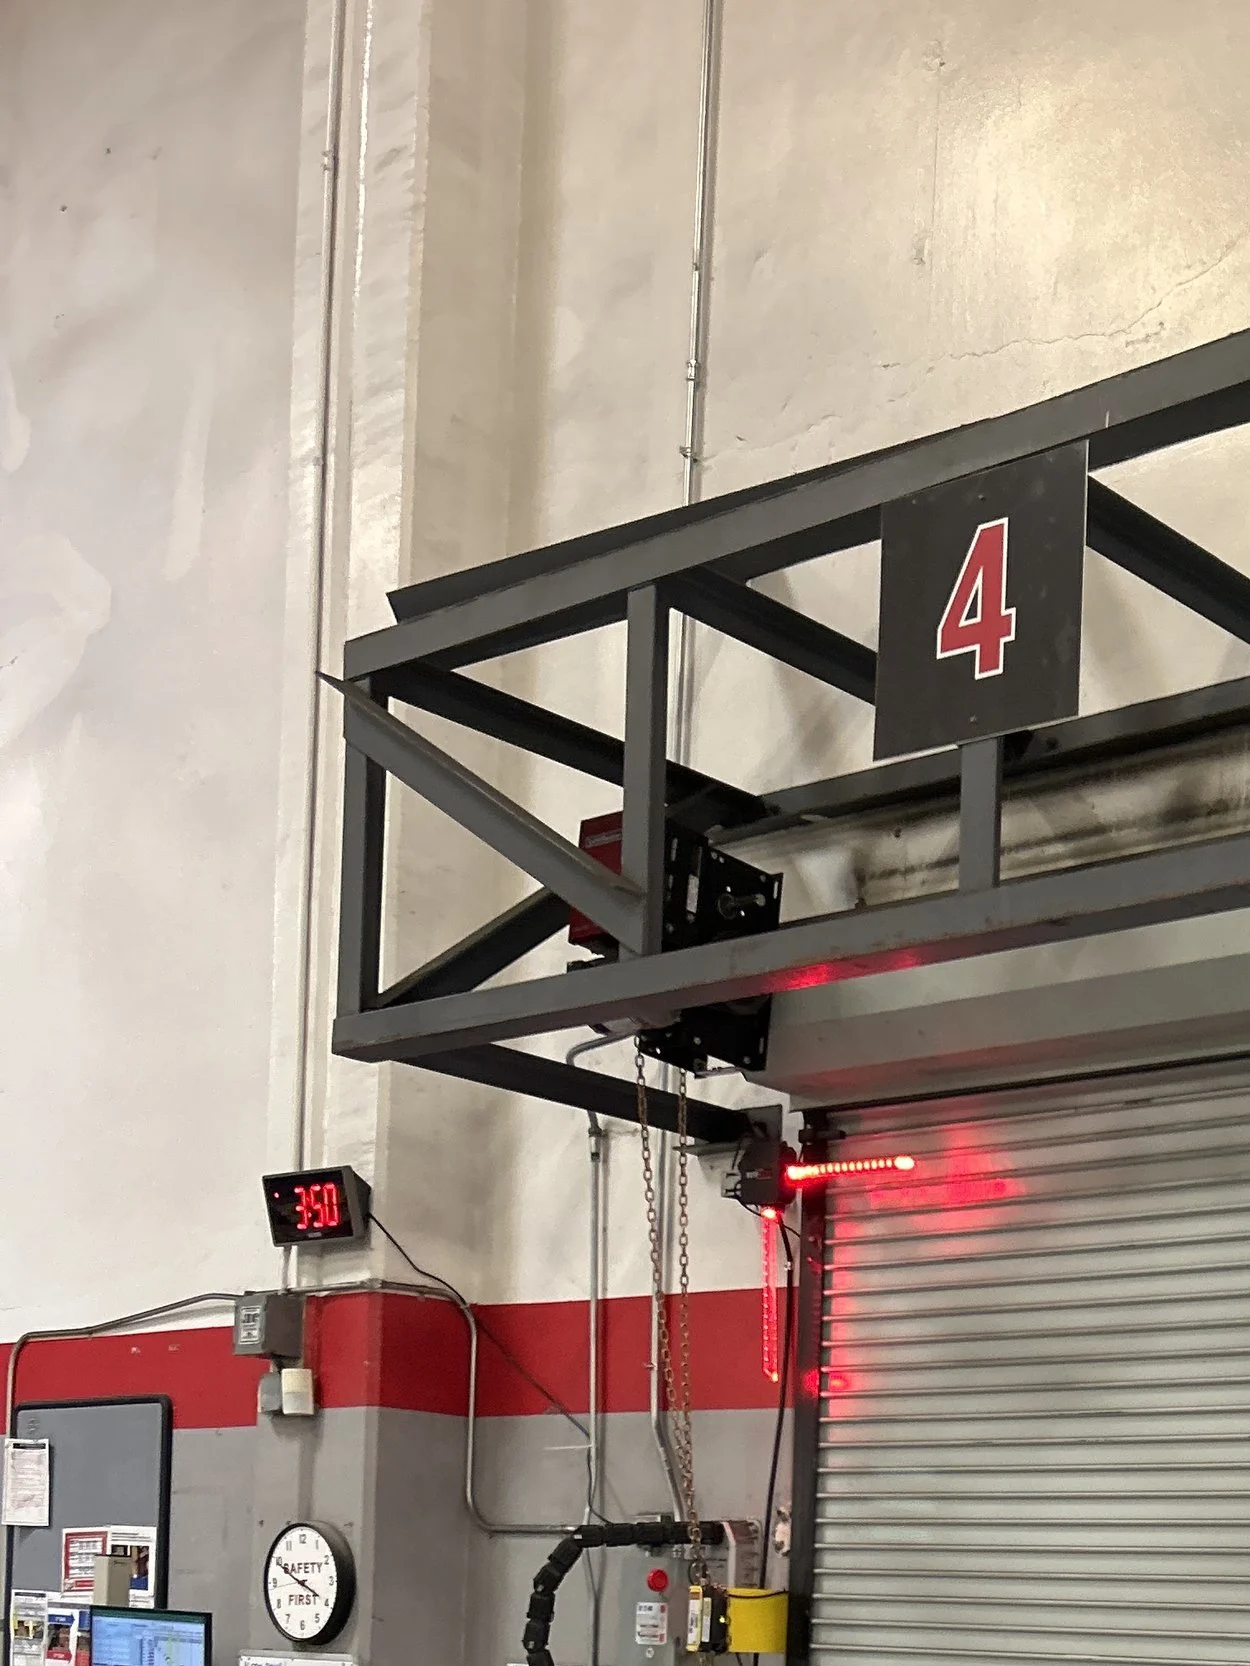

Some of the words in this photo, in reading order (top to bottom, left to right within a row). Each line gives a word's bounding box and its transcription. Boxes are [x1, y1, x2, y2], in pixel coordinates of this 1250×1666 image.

[936, 517, 1016, 680] 4
[299, 1534, 307, 1544] 12
[324, 1555, 330, 1565] 2
[283, 1562, 323, 1574] SAFETY
[329, 1576, 334, 1586] 3
[288, 1594, 318, 1606] FIRST
